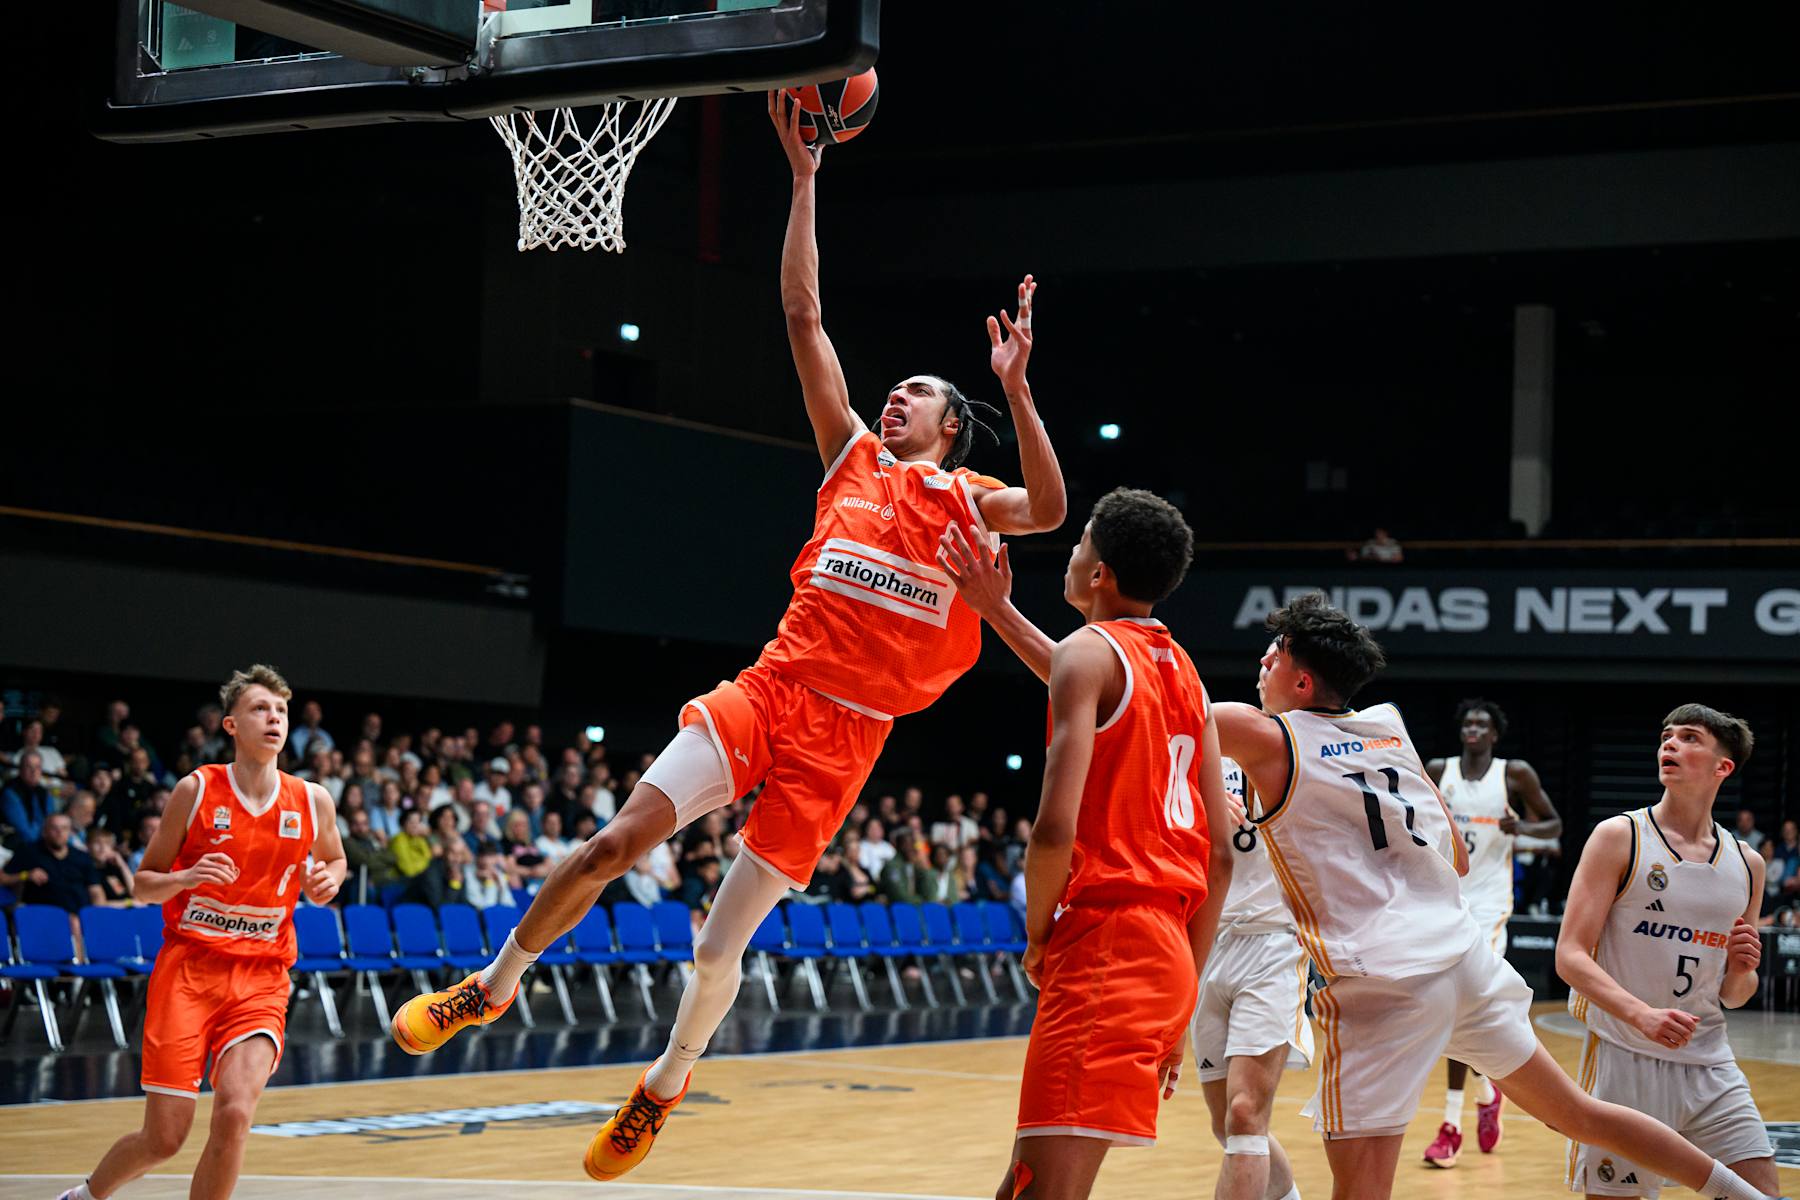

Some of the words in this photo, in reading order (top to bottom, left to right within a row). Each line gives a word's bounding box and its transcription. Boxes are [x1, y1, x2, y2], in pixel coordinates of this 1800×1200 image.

[840, 496, 881, 513] Allianz
[825, 557, 938, 606] ratiopharm
[1233, 586, 1490, 632] ADAS
[1514, 587, 1728, 635] NEXT
[1320, 736, 1402, 758] AUTOHERO
[1342, 766, 1428, 851] 11
[1633, 920, 1729, 950] AUTOHER
[1672, 953, 1700, 998] 5
